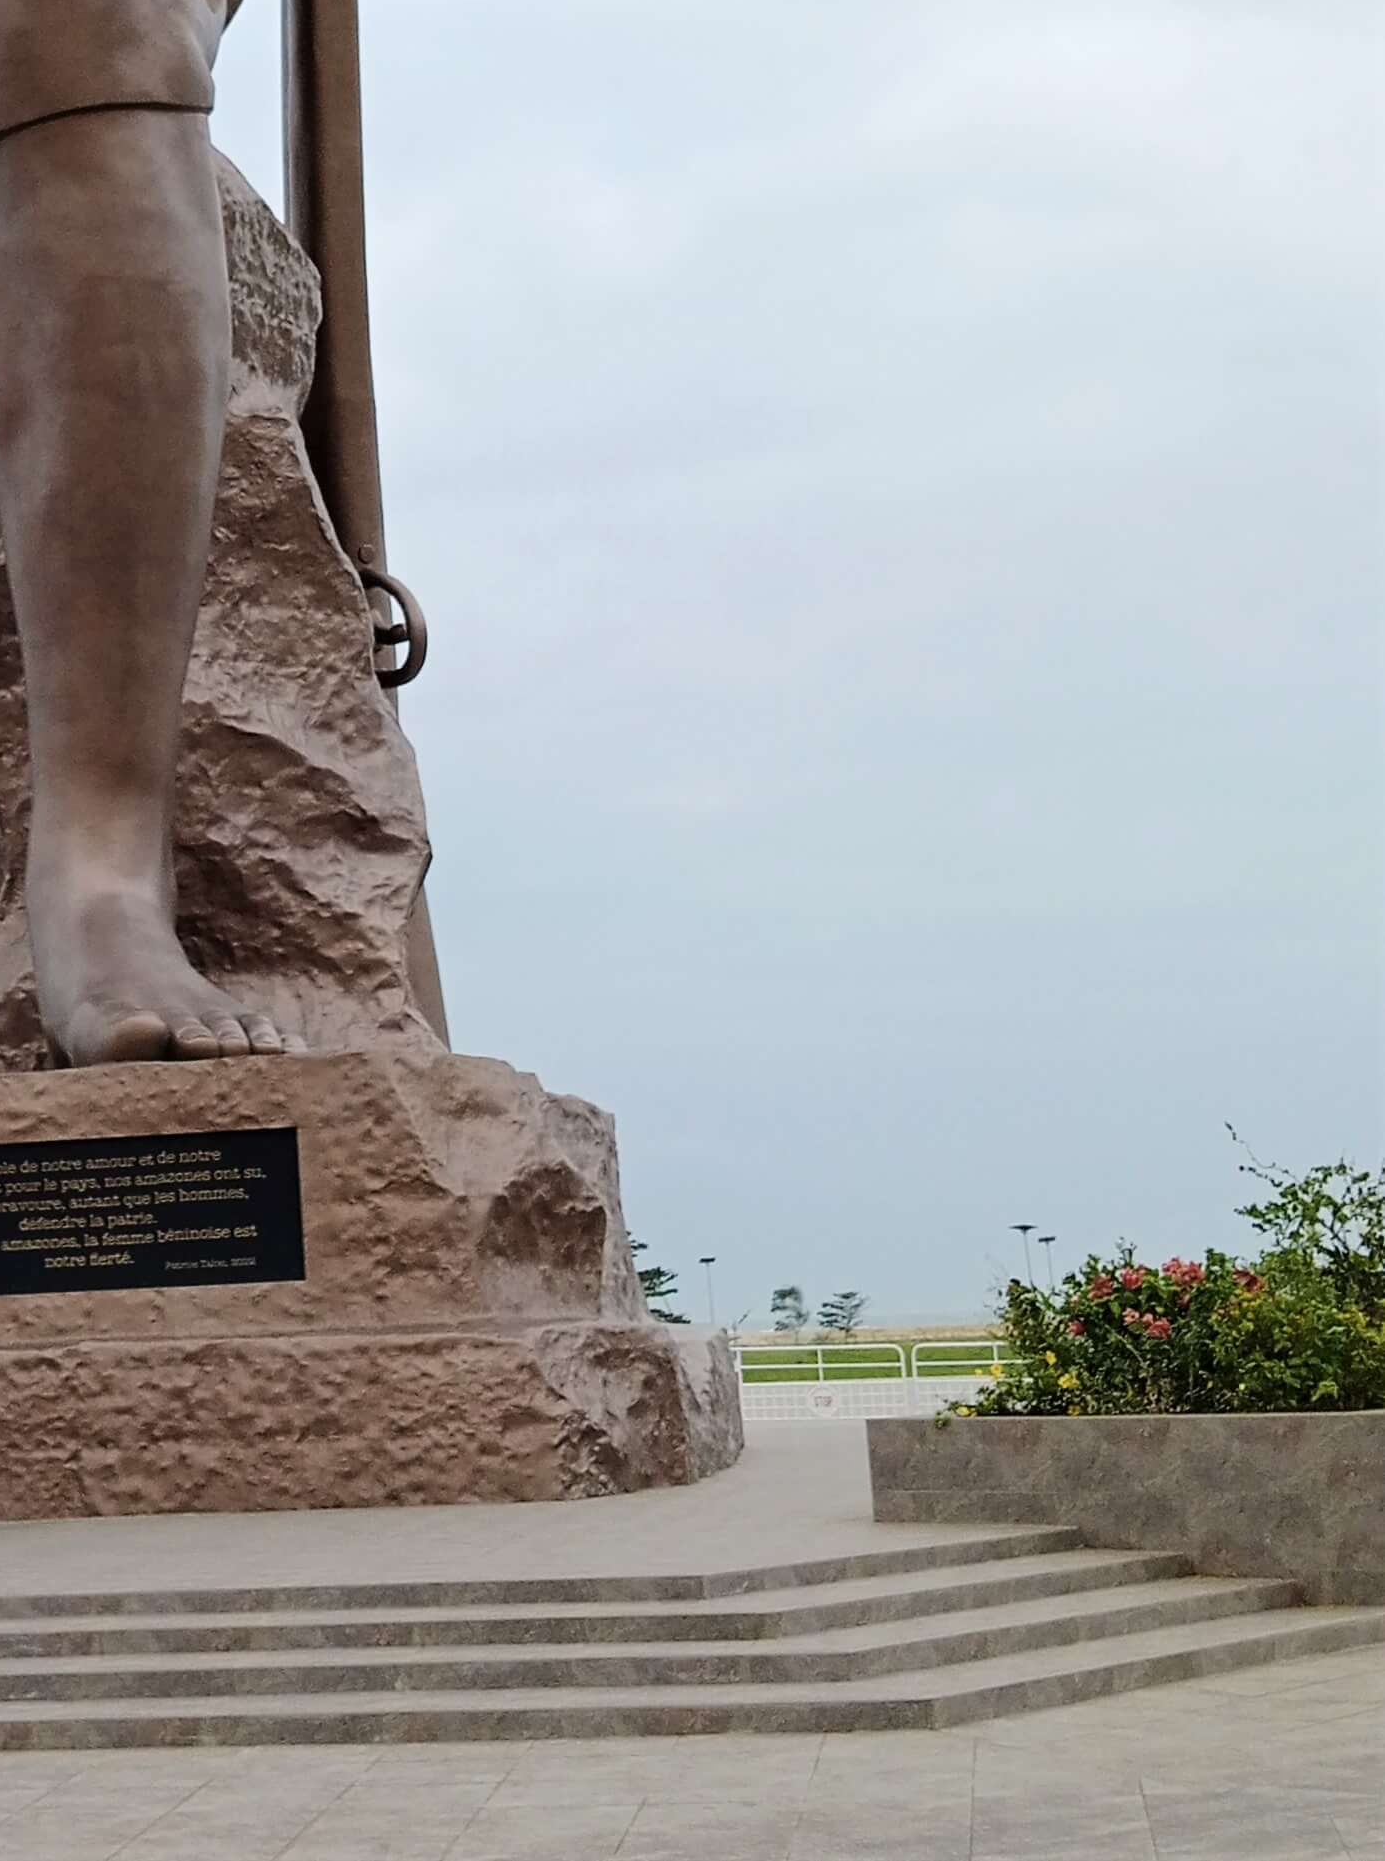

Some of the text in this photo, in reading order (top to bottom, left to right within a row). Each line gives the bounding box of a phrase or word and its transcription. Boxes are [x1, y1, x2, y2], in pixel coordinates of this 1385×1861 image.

[20, 1160, 37, 1173] de
[41, 1160, 82, 1172] notre
[86, 1156, 137, 1169] amour
[139, 1155, 155, 1165] et
[157, 1151, 175, 1164] de
[179, 1149, 221, 1162] notre
[5, 1182, 43, 1196] pour
[44, 1179, 57, 1190] le
[105, 1176, 131, 1188] nos
[134, 1170, 210, 1186] amazones
[213, 1168, 241, 1180] ont
[69, 1194, 120, 1209] autant
[123, 1194, 150, 1209] que
[154, 1191, 175, 1204] les
[89, 1215, 103, 1226] la
[107, 1212, 158, 1228] patrie.
[84, 1234, 99, 1246] la
[102, 1231, 155, 1245] femme
[157, 1227, 231, 1243] béninoise
[234, 1225, 258, 1237] est
[45, 1255, 86, 1268] notre
